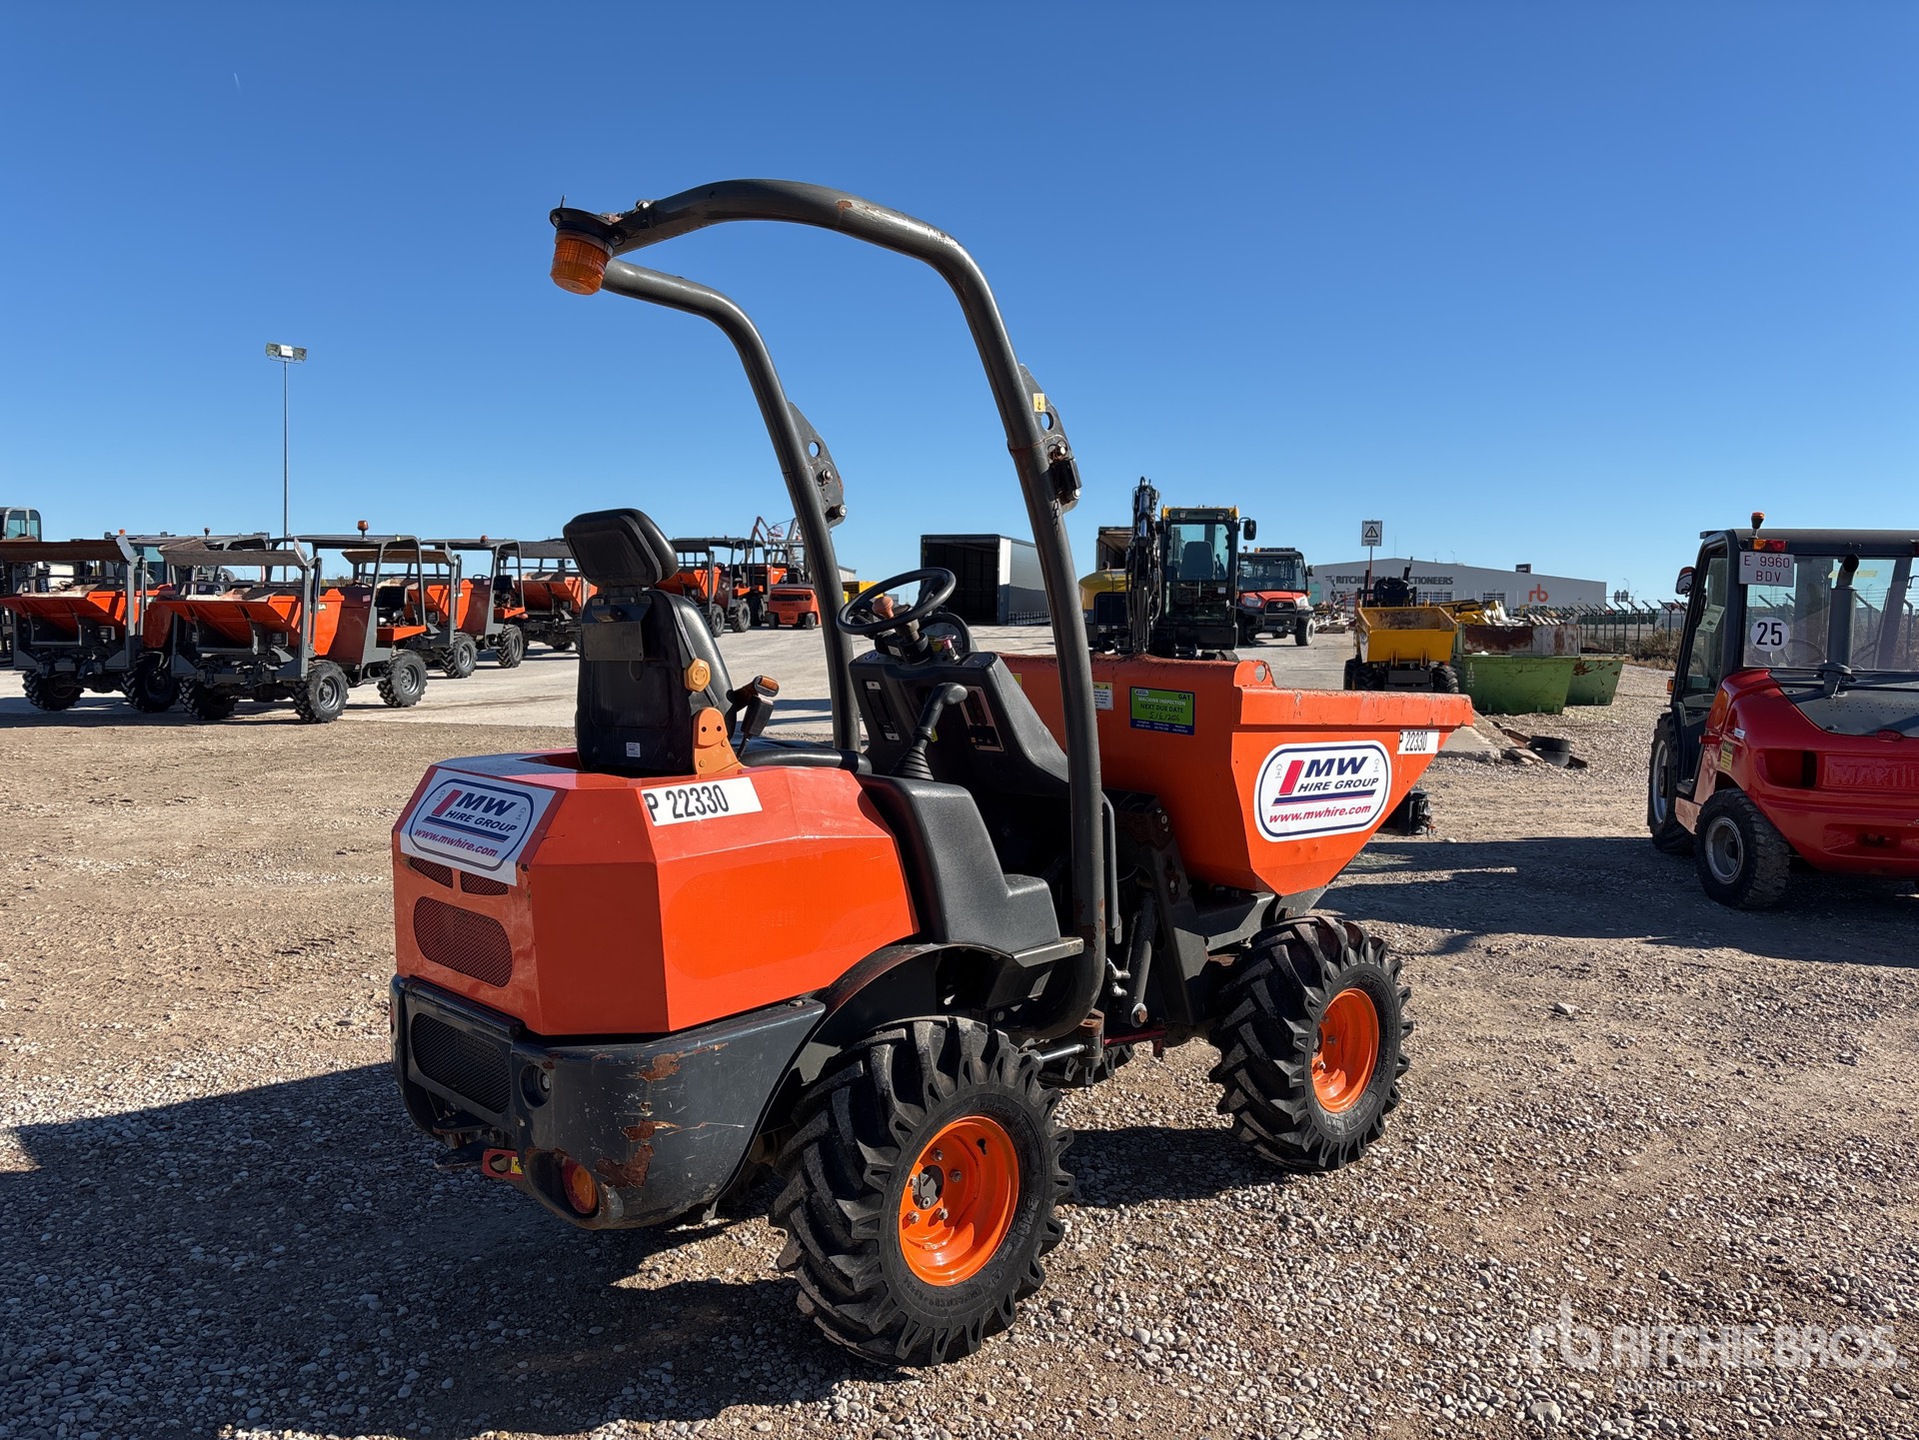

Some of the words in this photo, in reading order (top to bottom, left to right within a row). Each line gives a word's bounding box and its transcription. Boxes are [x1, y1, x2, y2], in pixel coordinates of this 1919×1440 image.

[1744, 555, 1751, 566] E
[1760, 556, 1790, 568] 9960
[1756, 570, 1781, 582] BDV
[1528, 583, 1549, 602] rb
[1756, 622, 1782, 646] 25
[1405, 731, 1428, 751] 22330
[1304, 756, 1369, 778] MW
[1297, 780, 1333, 793] HIRE
[1334, 777, 1379, 790] GROUP
[455, 792, 518, 817] MW
[643, 793, 659, 822] P
[665, 784, 730, 819] 22330
[1269, 804, 1371, 823] www.mwhire.com
[445, 810, 475, 823] HIRE
[474, 817, 518, 833] GROUP
[414, 829, 499, 857] www.mwhire.com
